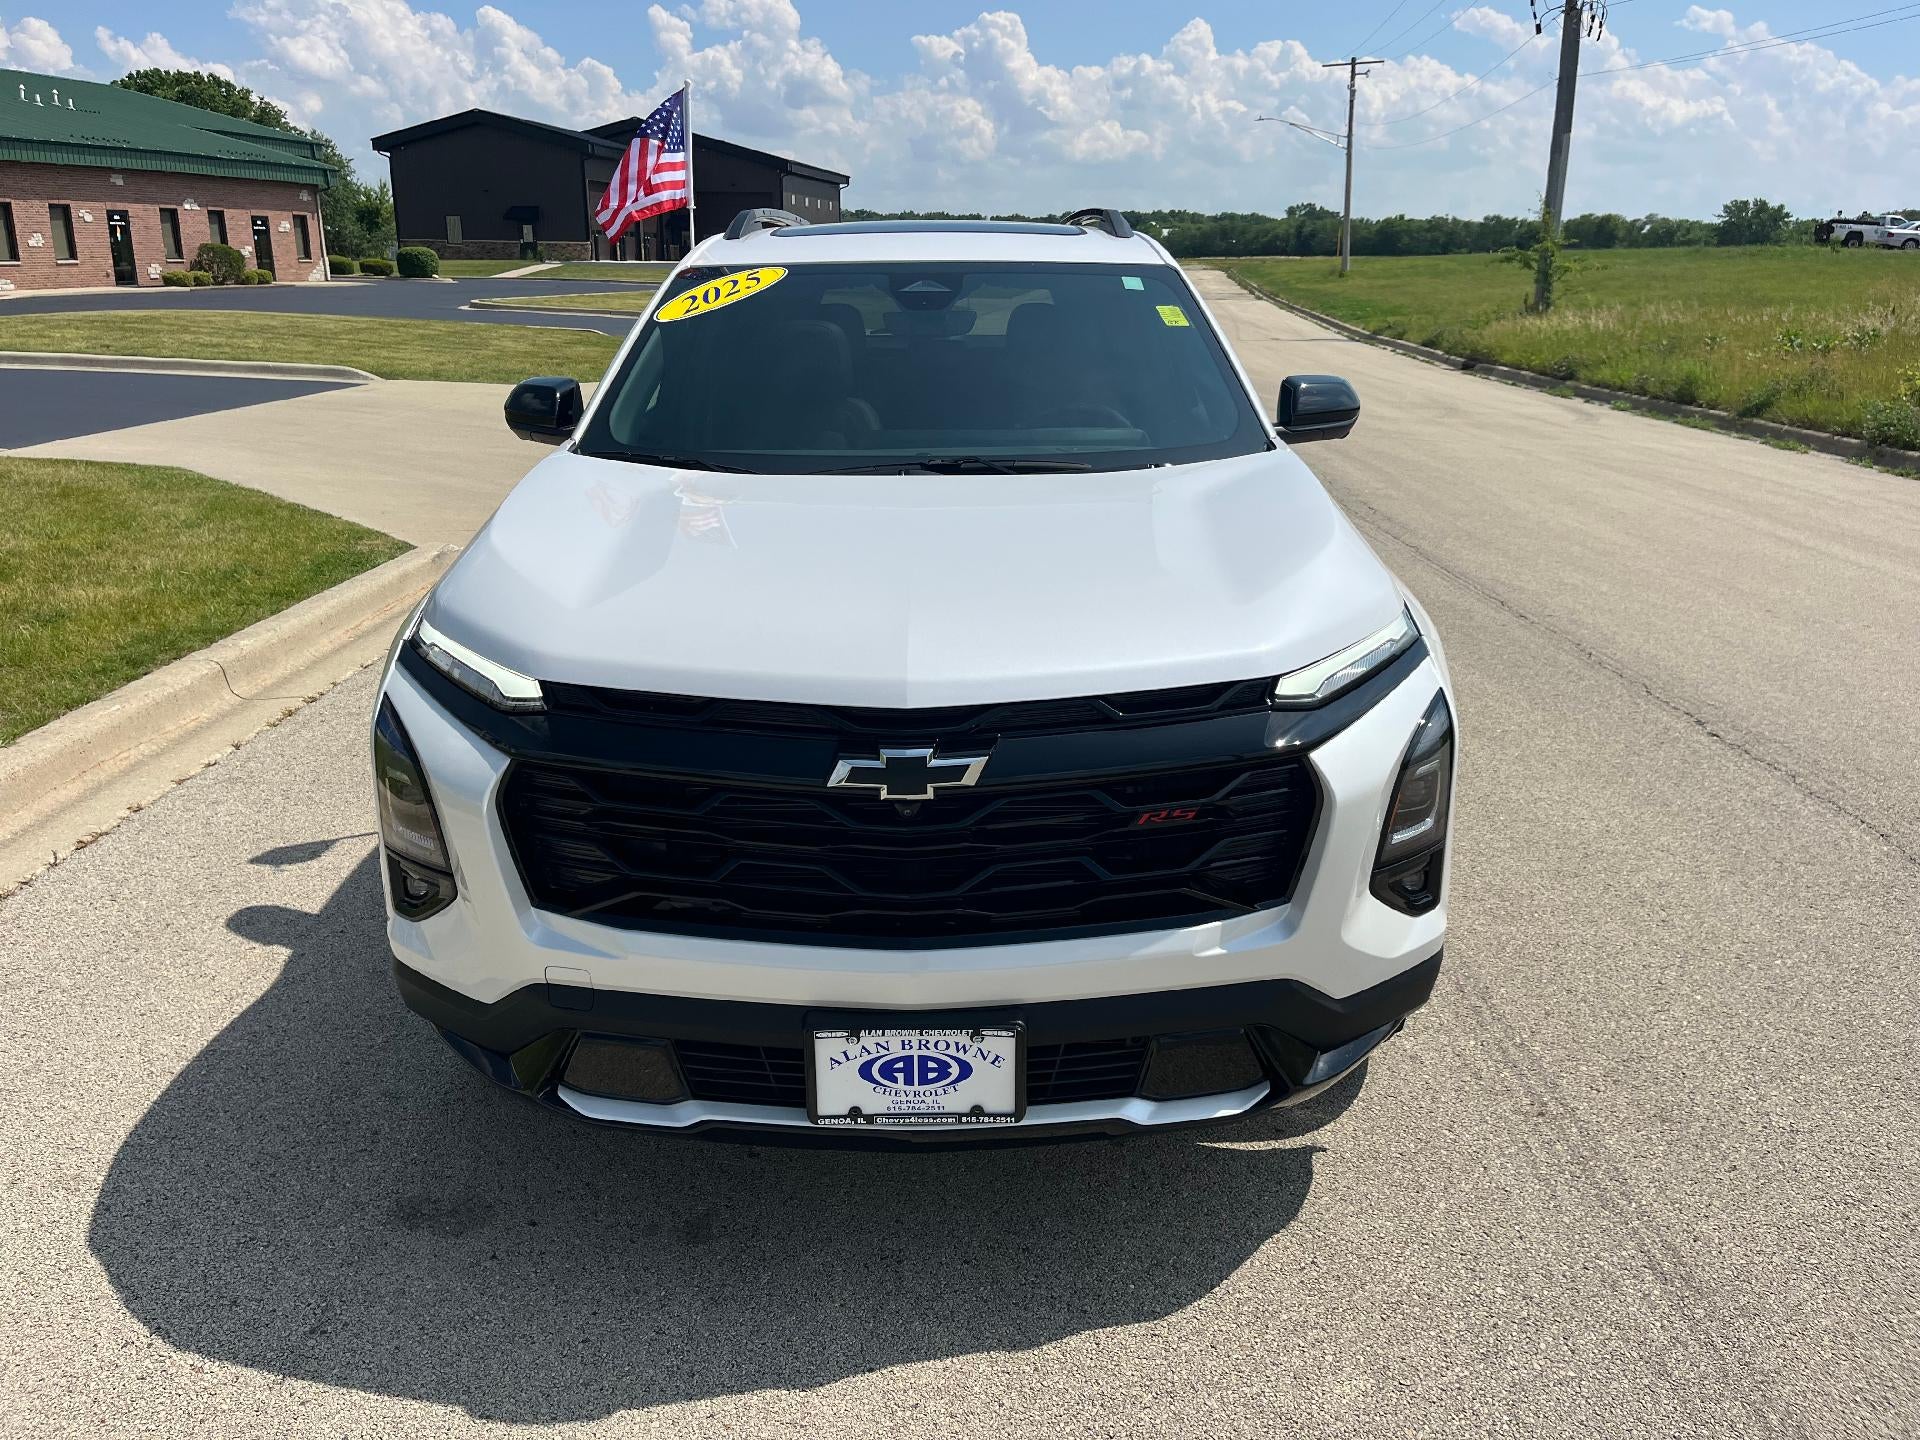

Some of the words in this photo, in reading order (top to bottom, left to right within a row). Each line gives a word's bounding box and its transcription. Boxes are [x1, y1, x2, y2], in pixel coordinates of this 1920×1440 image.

[682, 270, 761, 315] 2025
[1137, 807, 1200, 825] RS
[859, 1029, 883, 1037] ALAN
[885, 1029, 921, 1037] BROWNE
[923, 1029, 974, 1037] CHEVROLET
[829, 1040, 891, 1070] ALAN
[901, 1038, 1006, 1069] BROWNE
[877, 1054, 953, 1087] AB
[873, 1083, 960, 1098] CHEVROLET
[817, 1117, 855, 1125] GENOA,
[876, 1116, 957, 1125] Chevys4less.com
